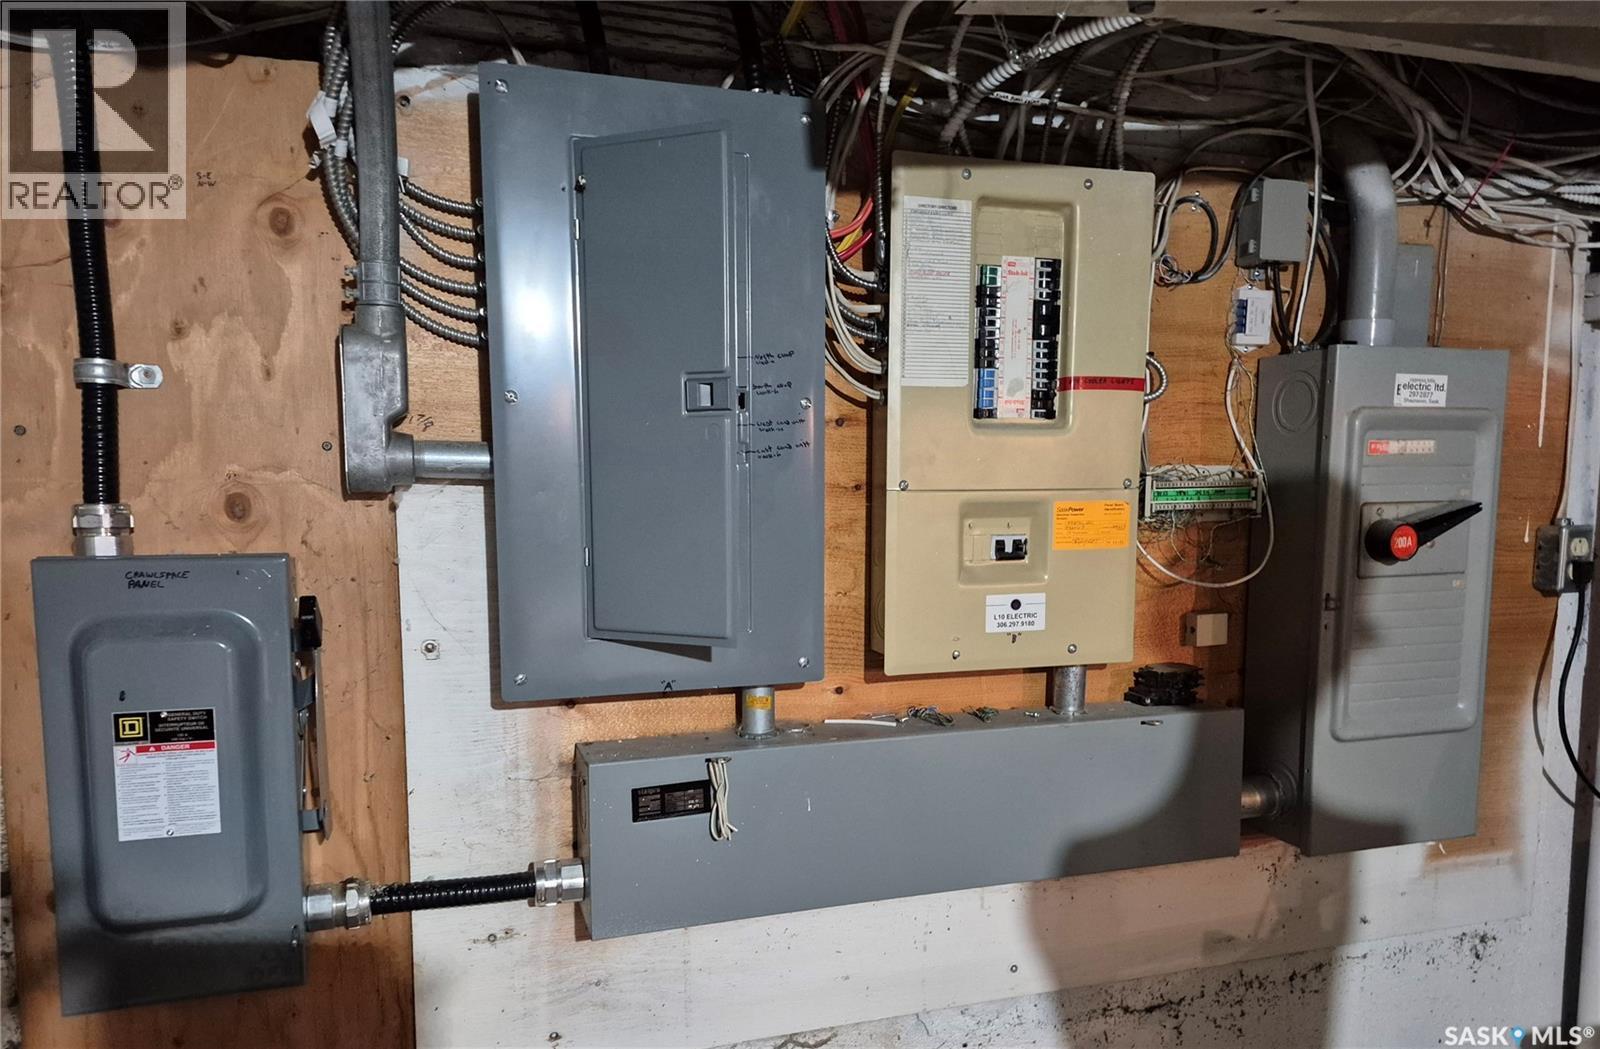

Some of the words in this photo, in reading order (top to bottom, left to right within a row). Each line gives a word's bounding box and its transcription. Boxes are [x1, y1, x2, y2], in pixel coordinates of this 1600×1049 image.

[1402, 382, 1432, 391] electric
[1394, 536, 1412, 549] 200A
[127, 579, 165, 589] PANEL
[1006, 612, 1038, 620] ELECTRIC
